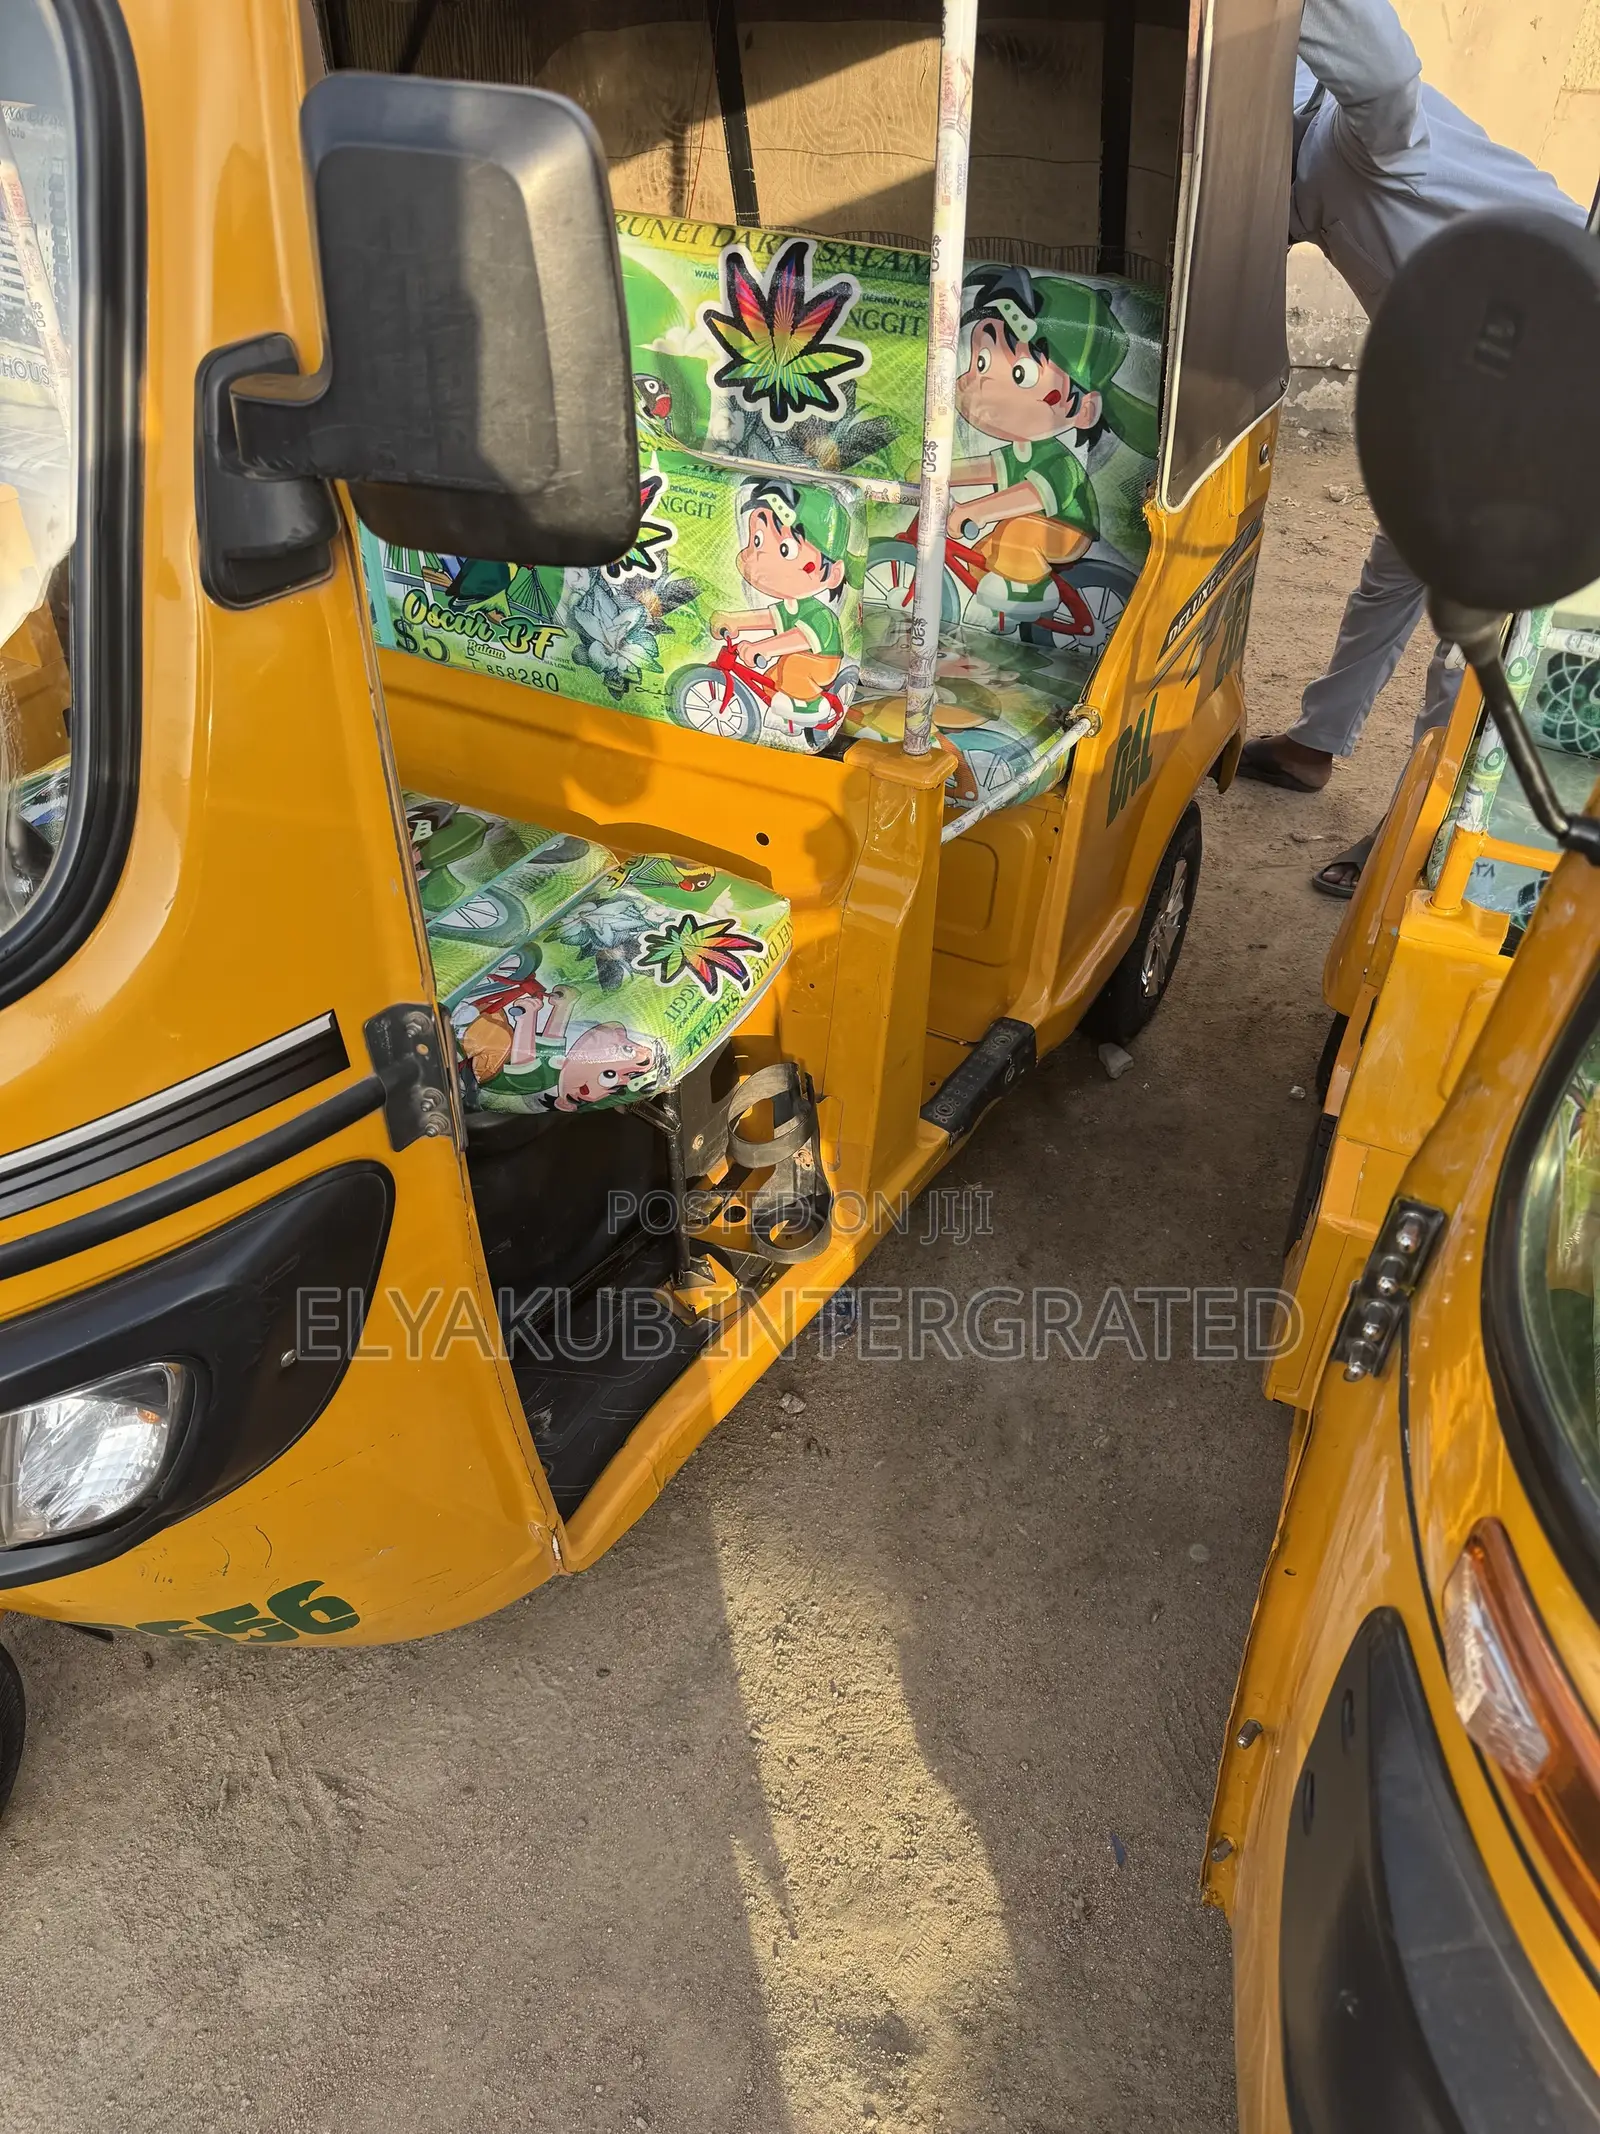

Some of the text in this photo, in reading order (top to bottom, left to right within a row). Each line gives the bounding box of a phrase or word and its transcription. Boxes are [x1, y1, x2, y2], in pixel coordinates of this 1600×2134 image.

[402, 587, 570, 661] Oscar BF
[1167, 573, 1217, 646] DELUXE
[393, 616, 451, 663] $5
[466, 638, 507, 661] Batam
[486, 664, 561, 692] 858280
